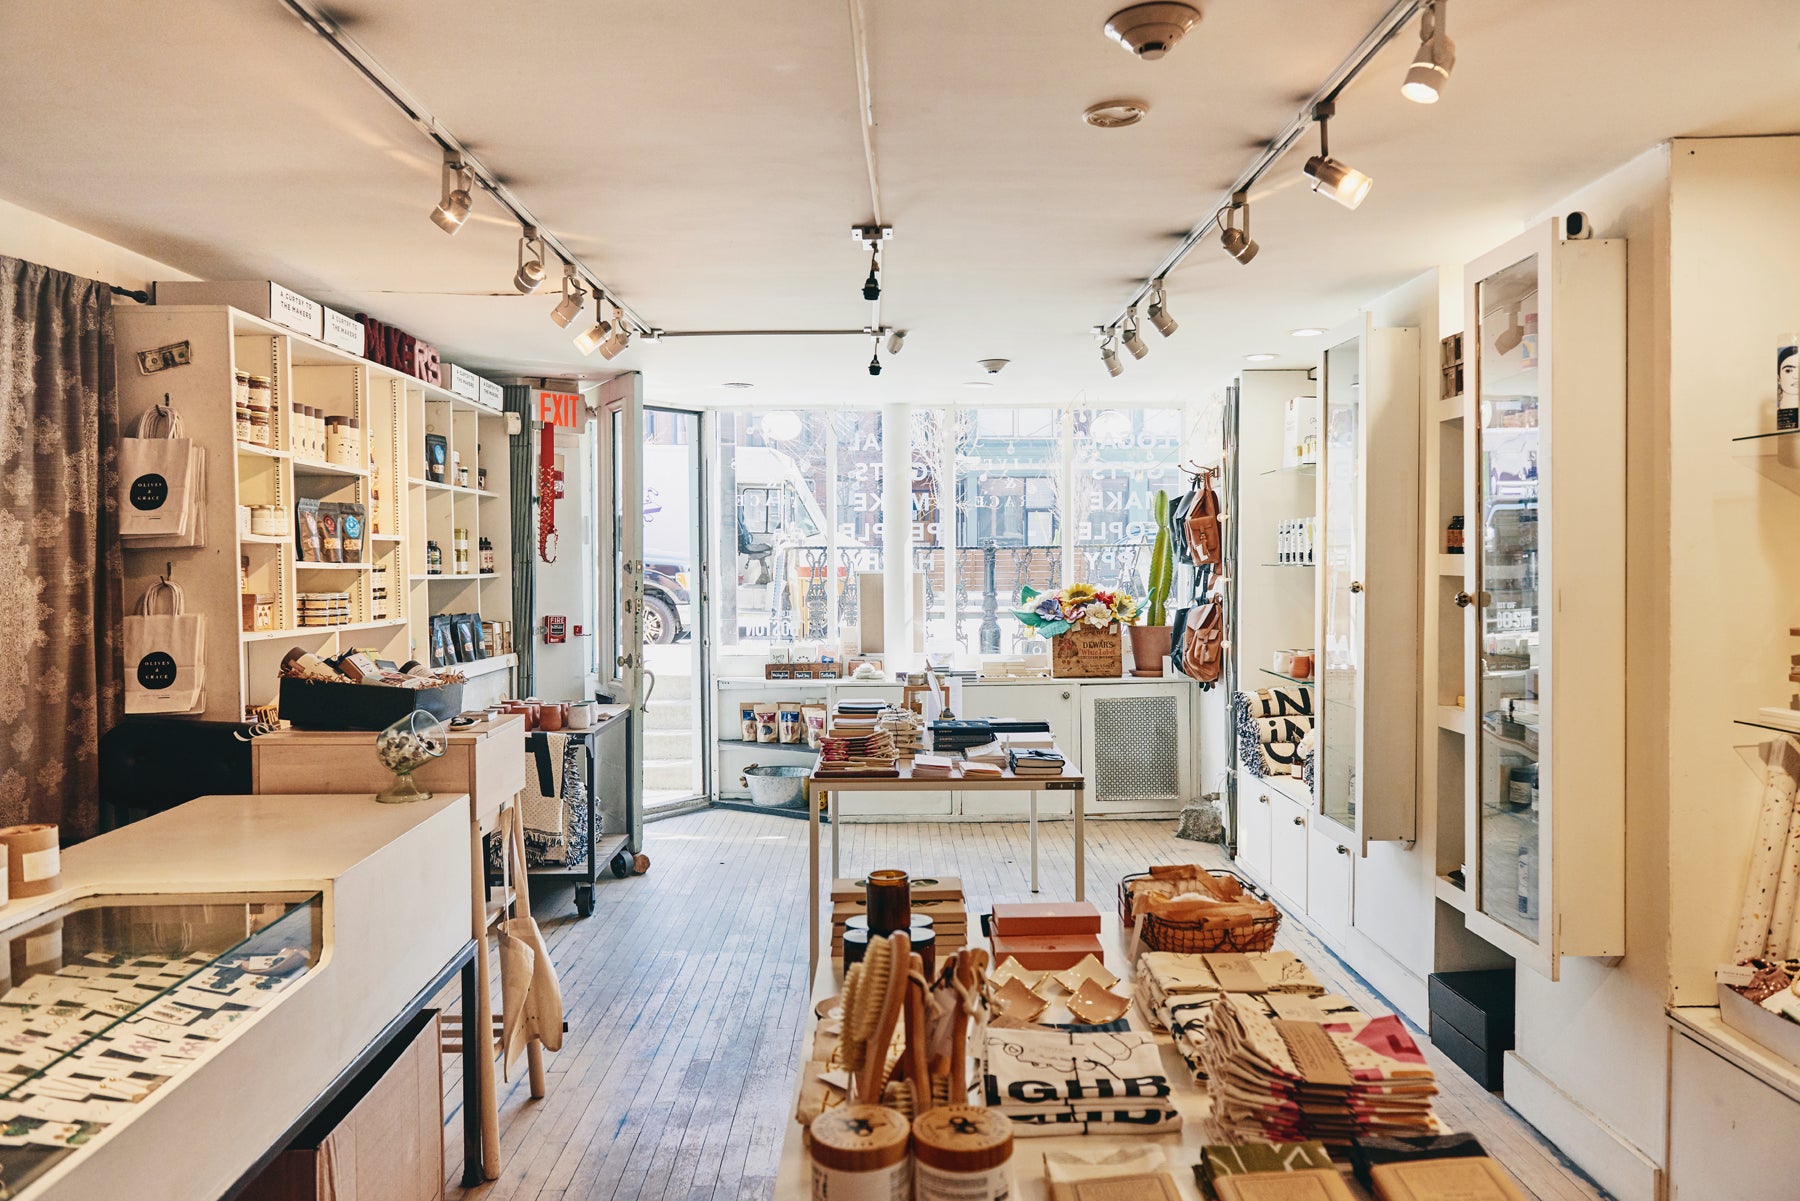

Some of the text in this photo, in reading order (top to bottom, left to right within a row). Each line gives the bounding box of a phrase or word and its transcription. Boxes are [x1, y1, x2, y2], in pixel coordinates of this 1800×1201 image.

[281, 300, 312, 320] THE MAKERS
[285, 293, 304, 305] CURTSY
[305, 302, 312, 310] TO
[355, 312, 442, 387] MAKERS
[540, 392, 579, 428] EXIT
[1082, 640, 1114, 649] DEWAR'S
